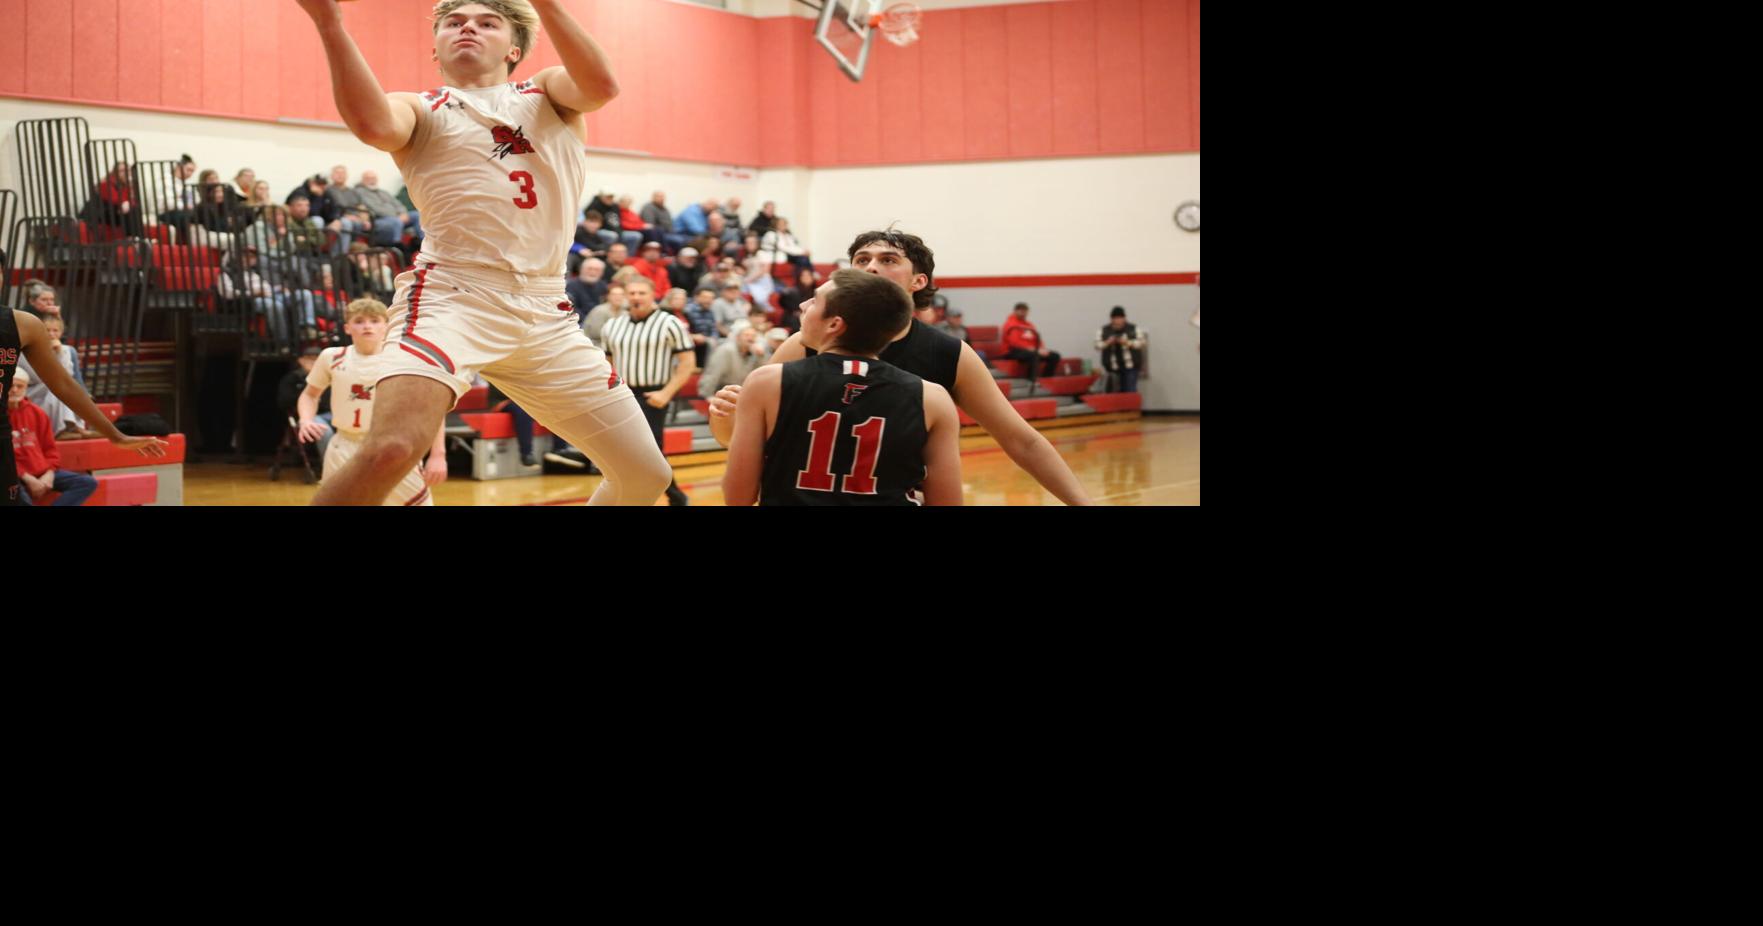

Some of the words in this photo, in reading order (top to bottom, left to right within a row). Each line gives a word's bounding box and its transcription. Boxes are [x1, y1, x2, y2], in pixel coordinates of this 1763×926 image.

[508, 171, 538, 210] 3
[841, 382, 869, 405] F
[353, 408, 361, 428] 1
[796, 410, 886, 495] 11
